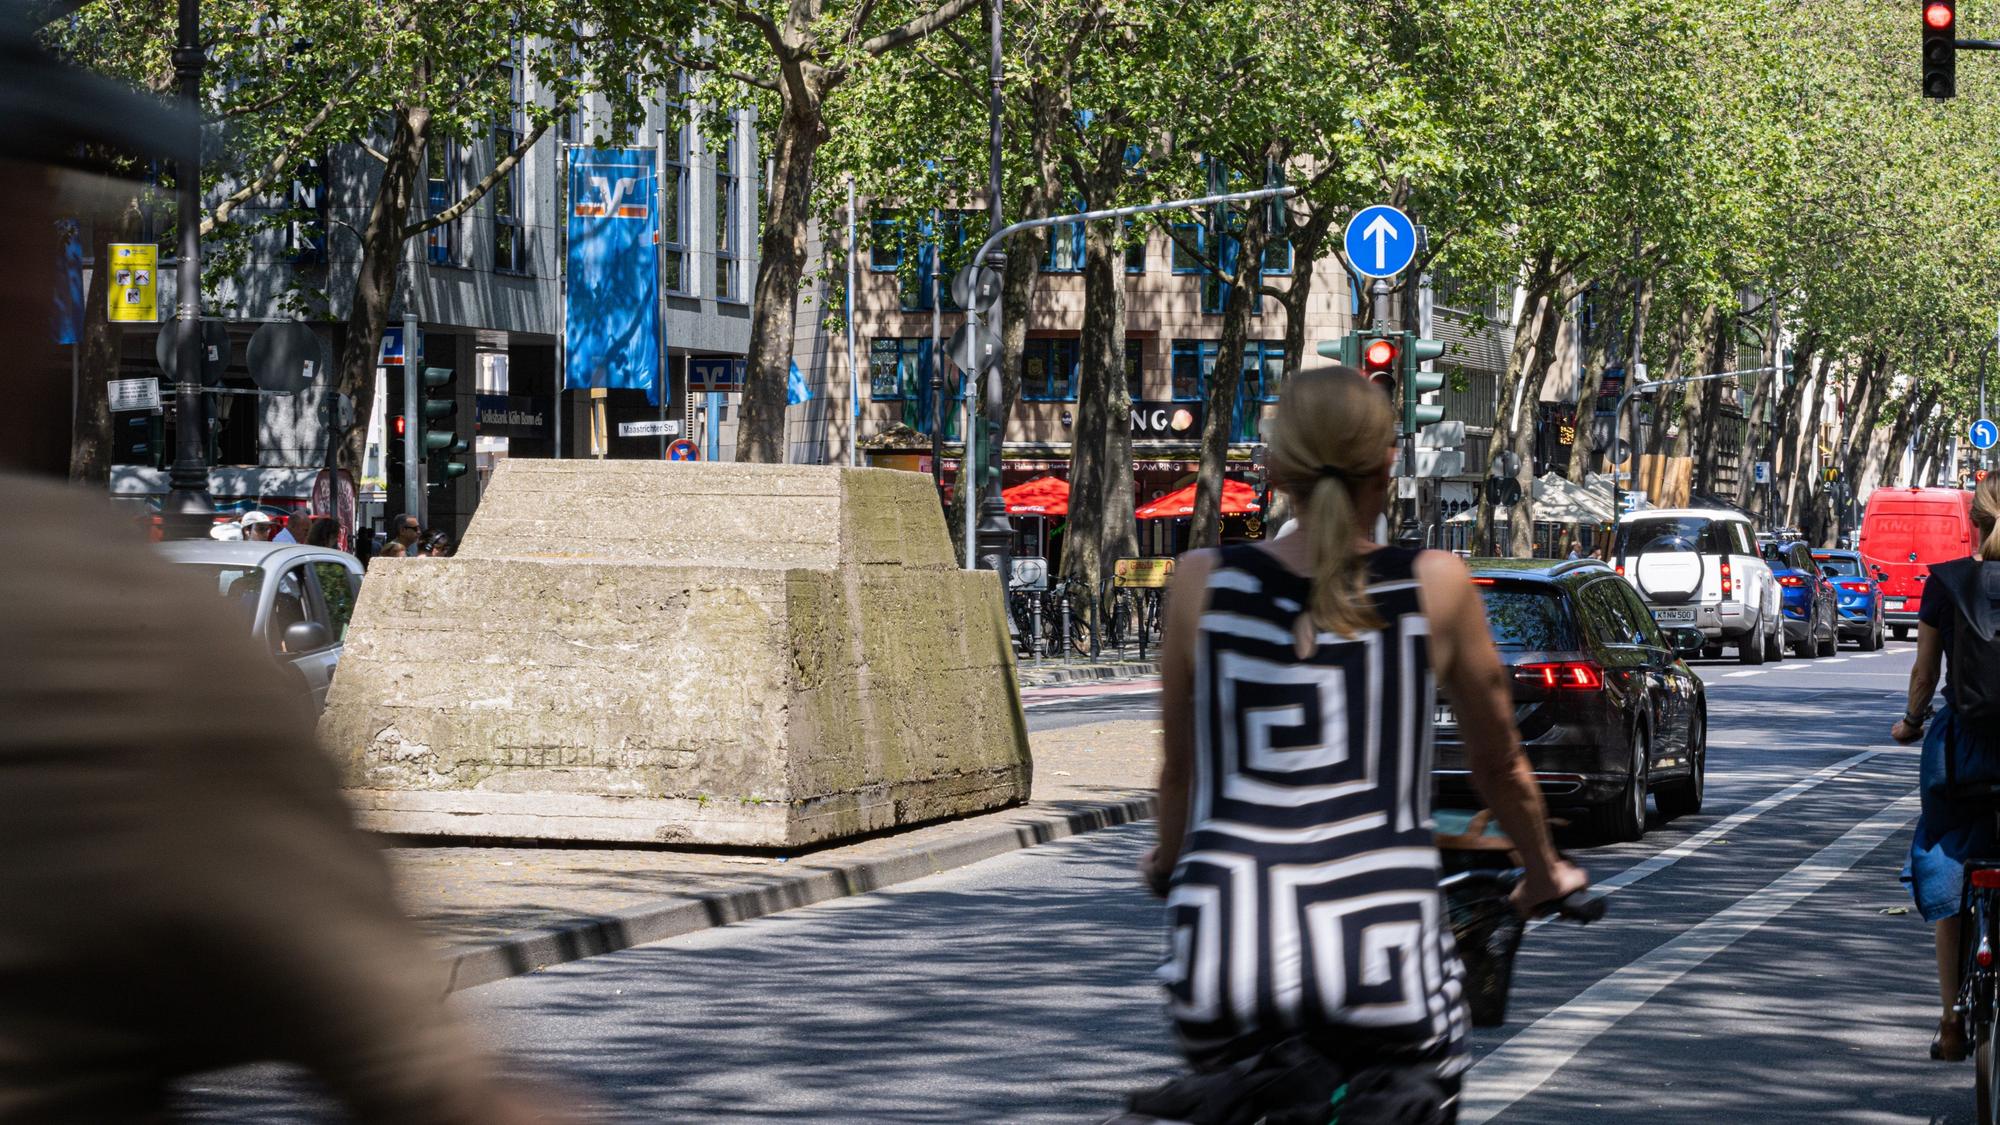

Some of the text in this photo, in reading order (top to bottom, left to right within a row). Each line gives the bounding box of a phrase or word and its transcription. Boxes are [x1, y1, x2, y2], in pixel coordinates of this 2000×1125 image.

[481, 409, 508, 424] Volksbank
[623, 425, 663, 433] Maastrichter
[1142, 463, 1157, 471] AM
[1158, 462, 1180, 471] RING
